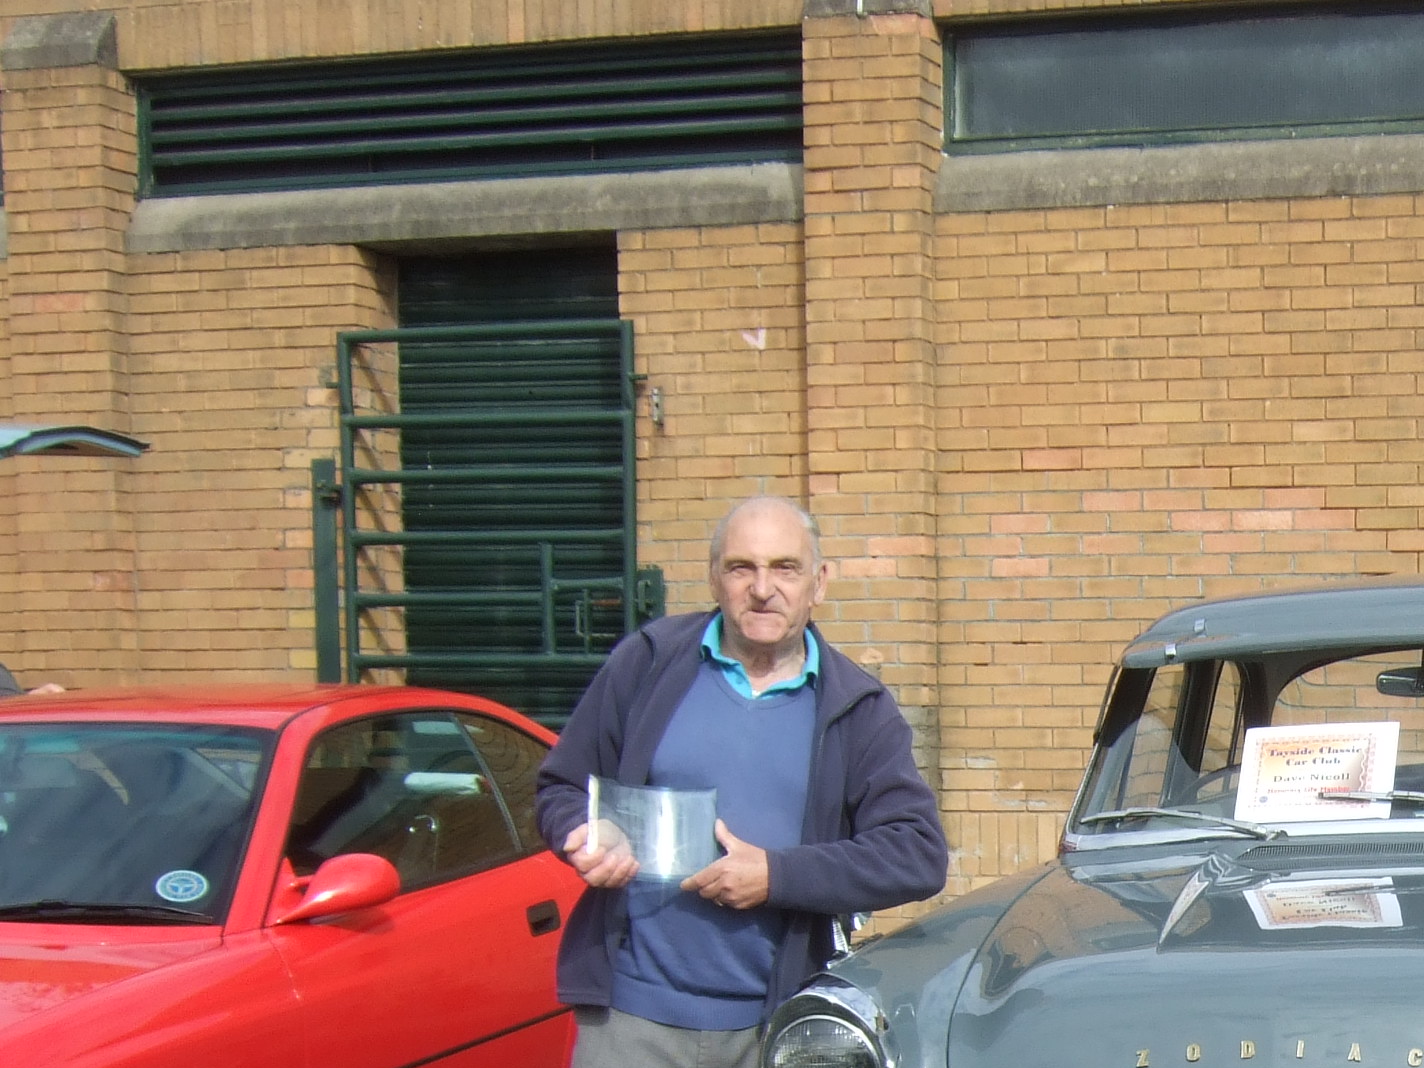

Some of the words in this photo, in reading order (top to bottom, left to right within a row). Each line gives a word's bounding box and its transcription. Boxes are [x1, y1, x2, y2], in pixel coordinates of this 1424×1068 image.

[1269, 747, 1314, 758] Tayside
[1319, 745, 1361, 755] Classic
[1286, 758, 1308, 766] Car
[1312, 757, 1341, 765] Club
[1273, 775, 1305, 783] Dave
[1310, 772, 1350, 781] Nicoll
[1136, 1040, 1423, 1068] ZODIAC
